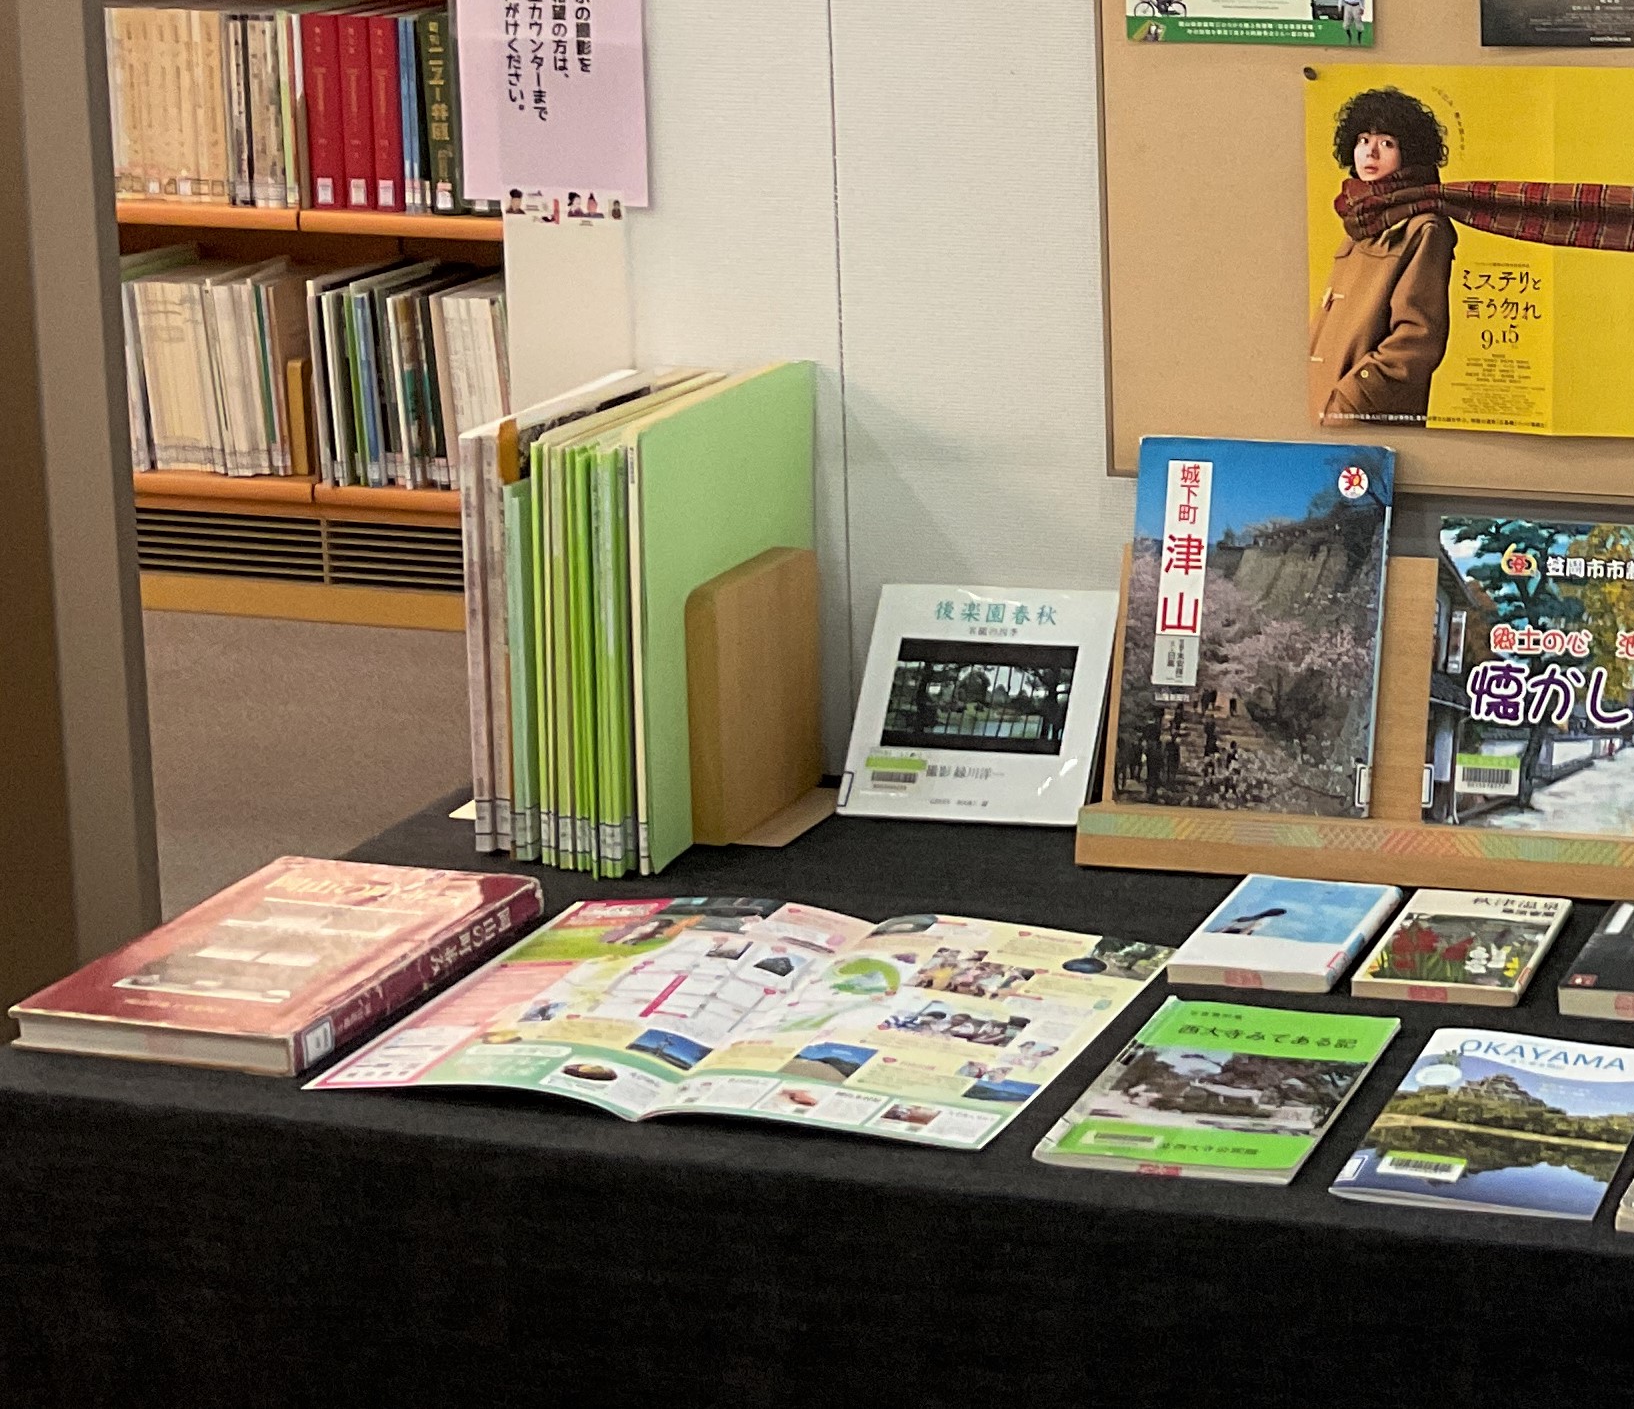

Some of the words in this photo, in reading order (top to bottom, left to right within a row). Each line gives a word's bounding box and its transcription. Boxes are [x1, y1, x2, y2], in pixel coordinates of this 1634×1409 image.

[1462, 269, 1542, 294] ミステリと
[1461, 296, 1542, 321] 言う勿れ
[1481, 323, 1520, 350] 9.15
[1177, 462, 1201, 525] 城下町
[1159, 533, 1205, 635] 津山
[934, 600, 1058, 627] 後楽園春秋
[1489, 623, 1592, 655] 郷土の心
[1458, 1037, 1628, 1074] OKAYAMA
